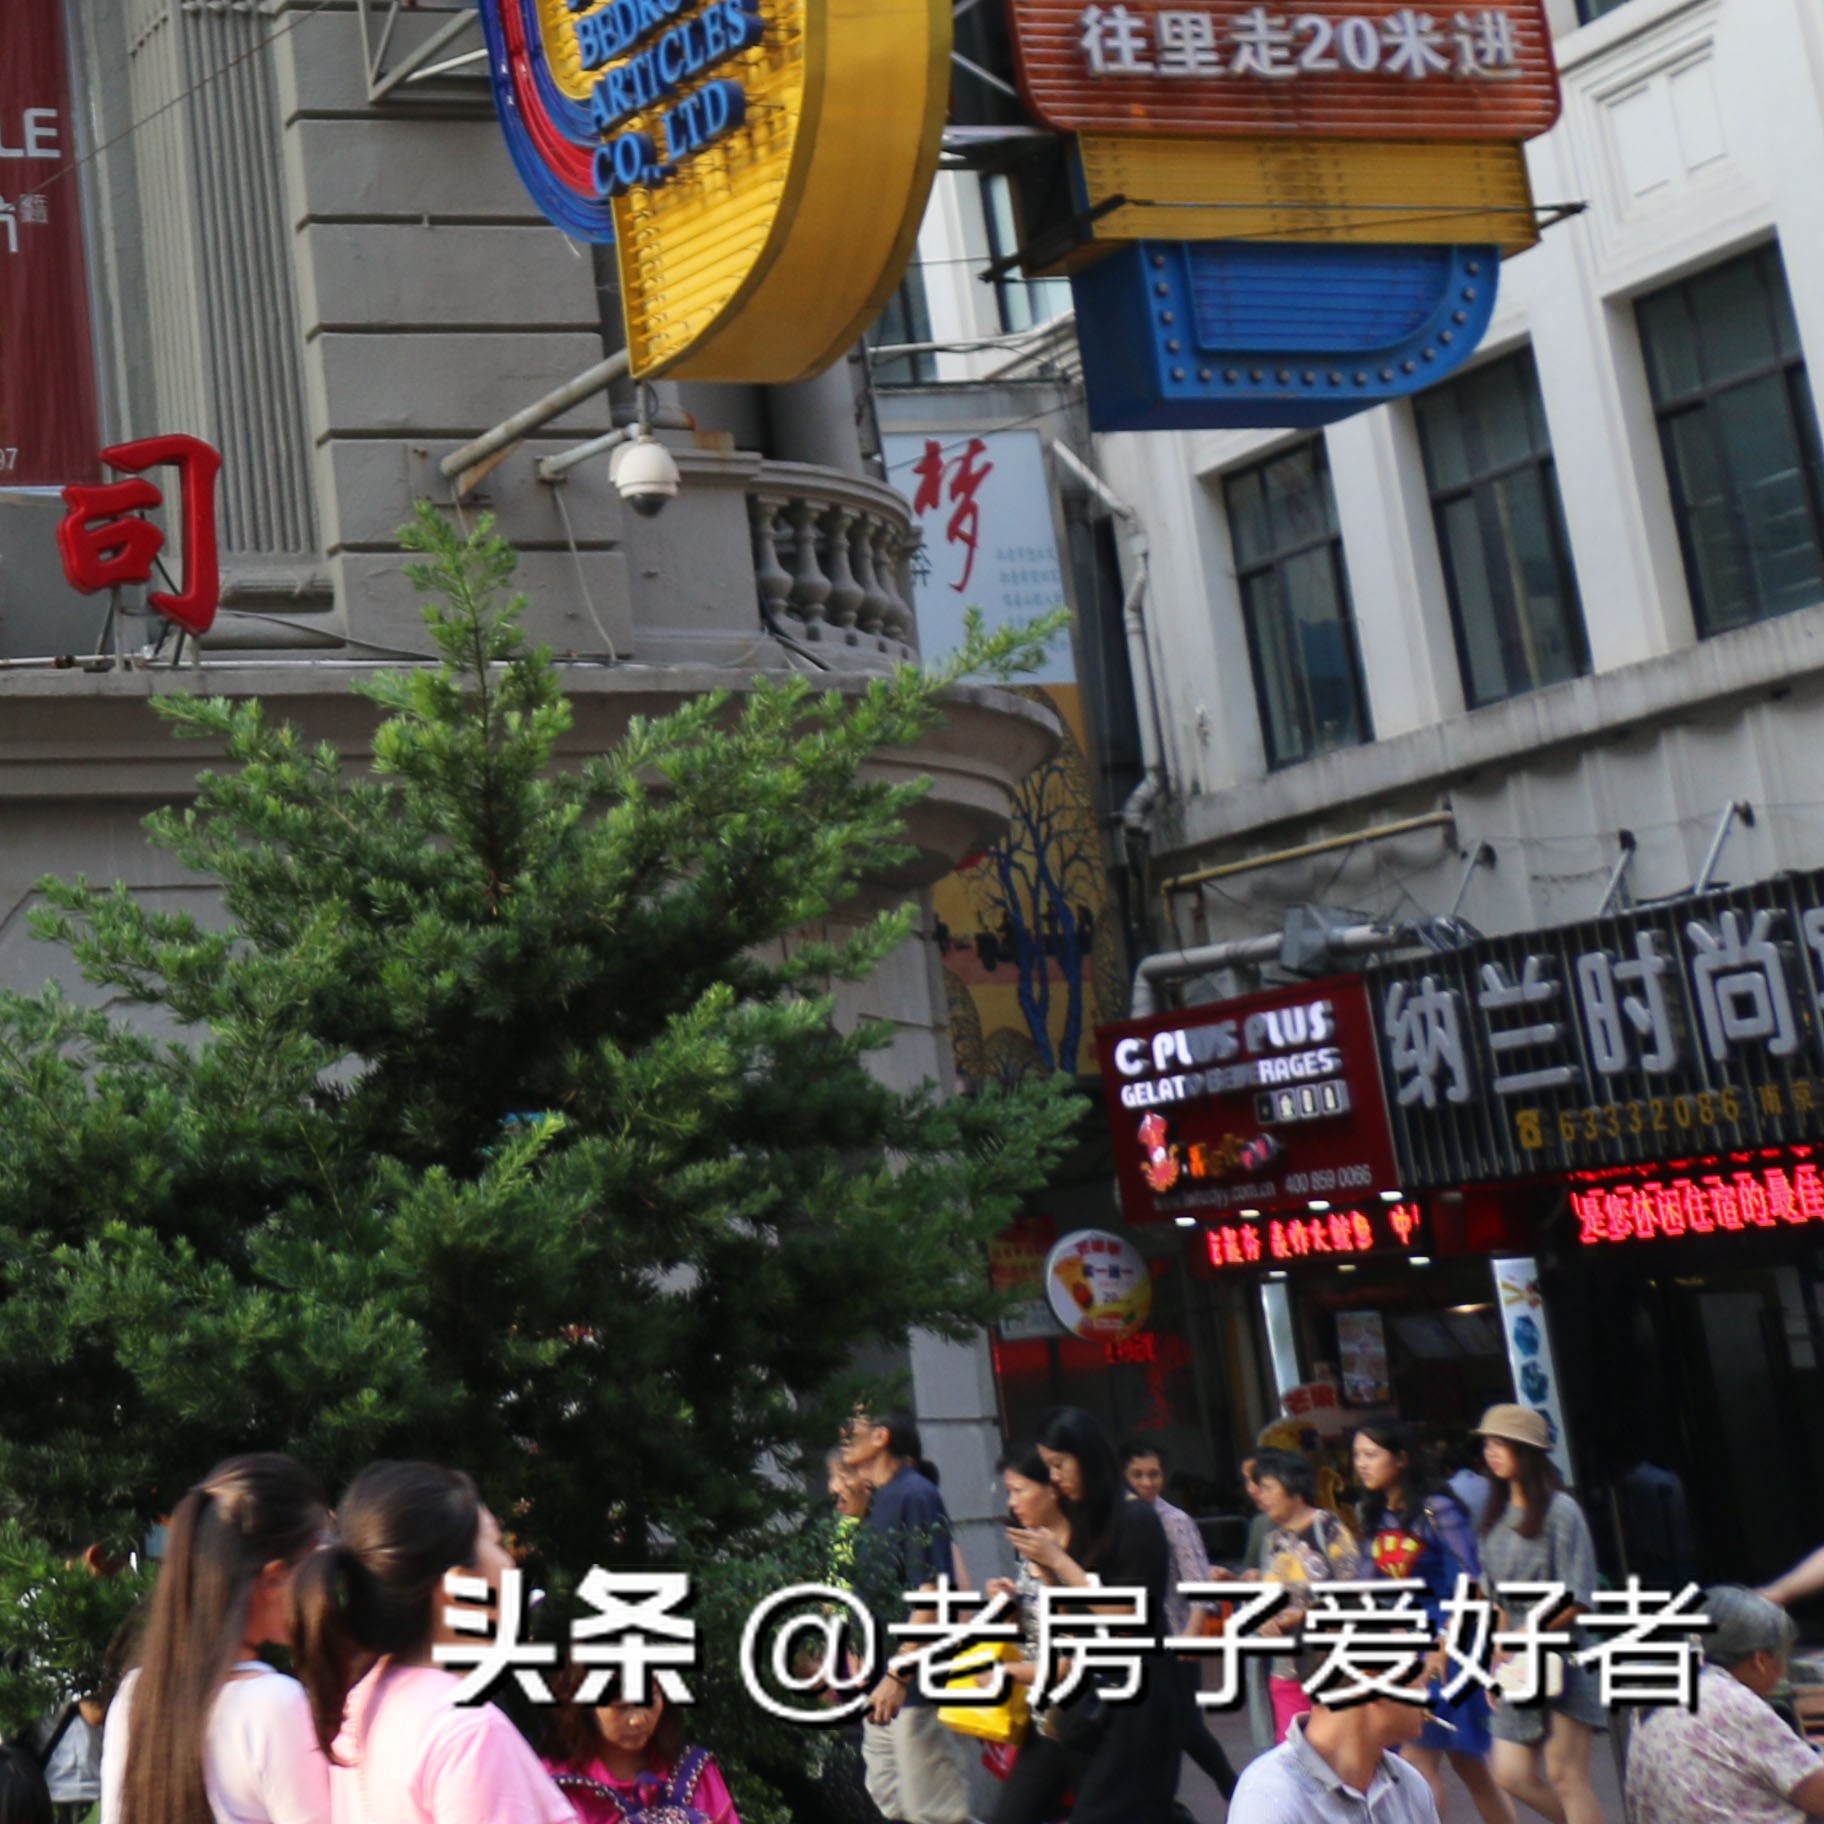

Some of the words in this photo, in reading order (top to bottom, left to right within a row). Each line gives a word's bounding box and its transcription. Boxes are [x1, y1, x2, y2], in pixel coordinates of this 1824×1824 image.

[1077, 8, 1522, 84] 往里走20米进
[1385, 908, 1824, 1110] 纳兰时尚
[1560, 1087, 1739, 1142] 63332086
